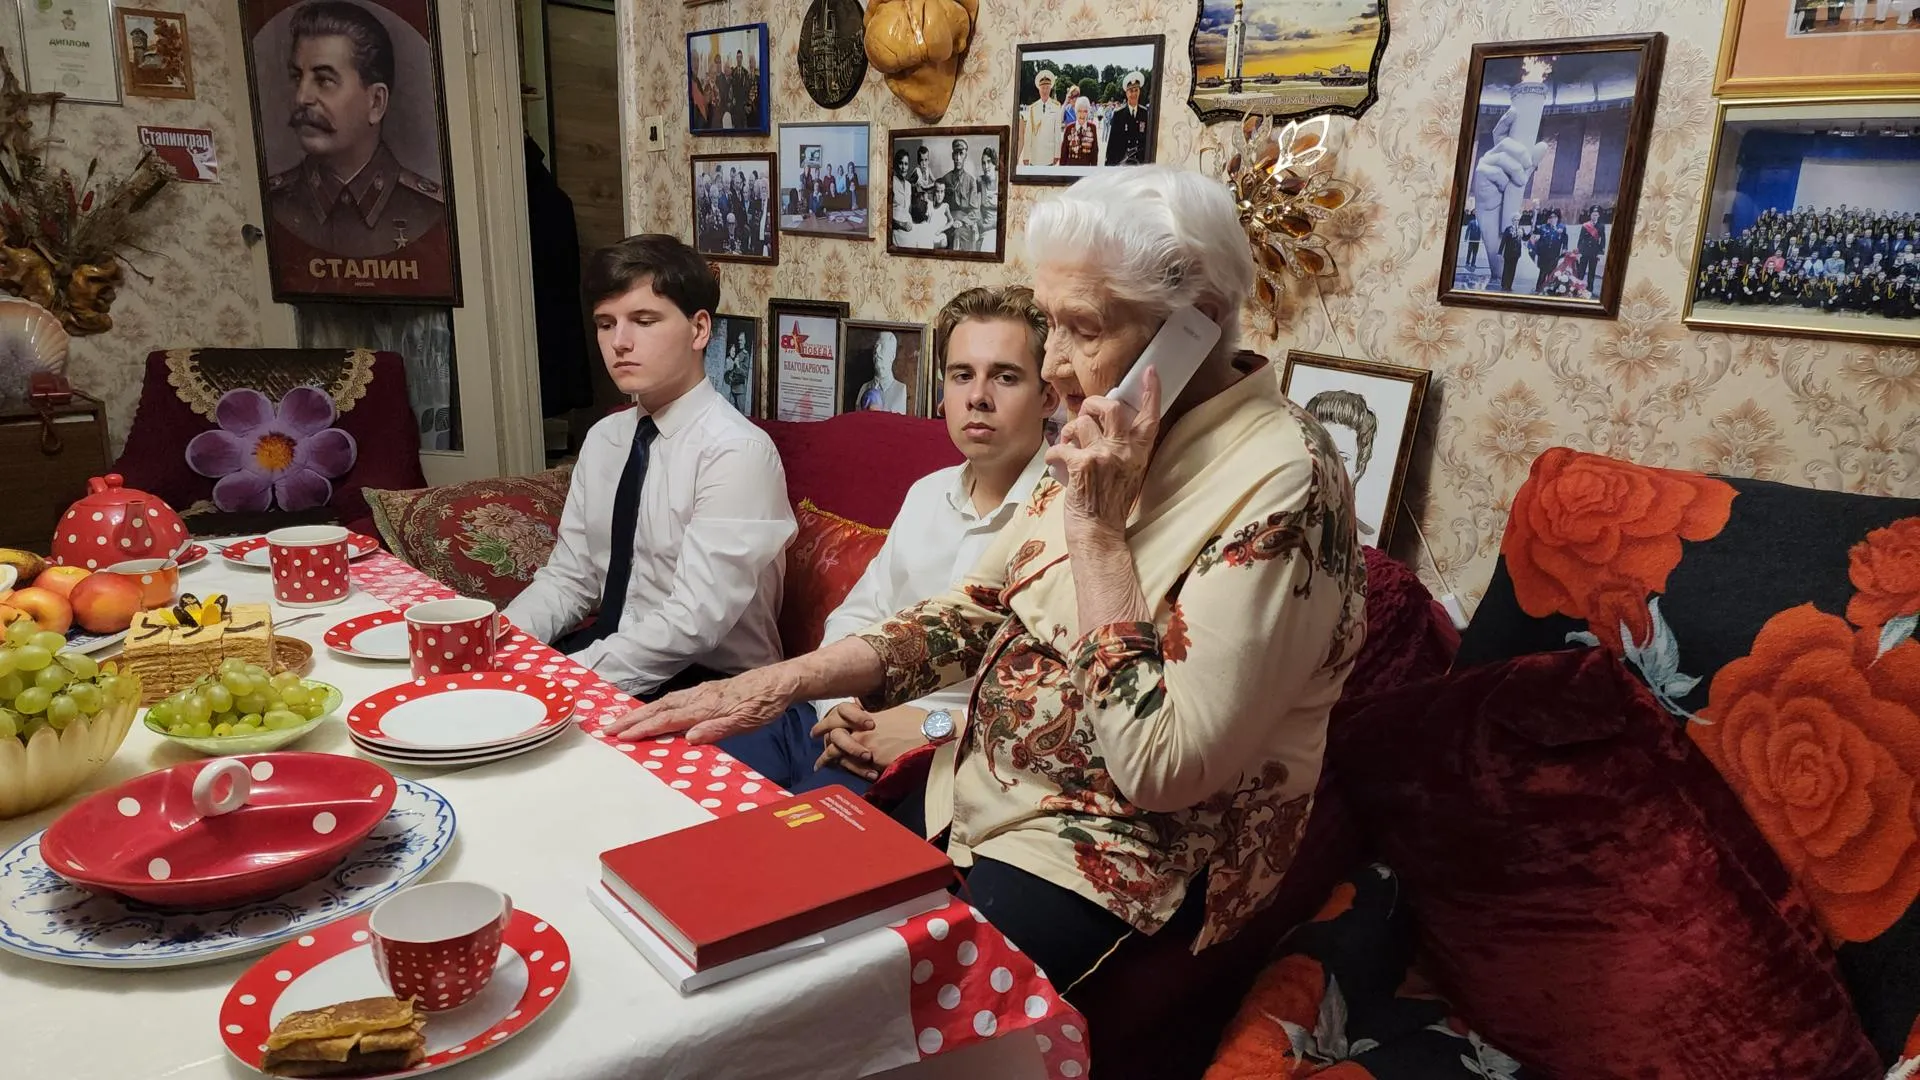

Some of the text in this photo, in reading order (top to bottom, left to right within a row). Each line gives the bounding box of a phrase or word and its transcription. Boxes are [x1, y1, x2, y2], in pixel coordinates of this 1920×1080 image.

[49, 38, 90, 48] ДИПЛОМ
[140, 127, 210, 150] Сталинград
[309, 258, 419, 280] СТАЛИН
